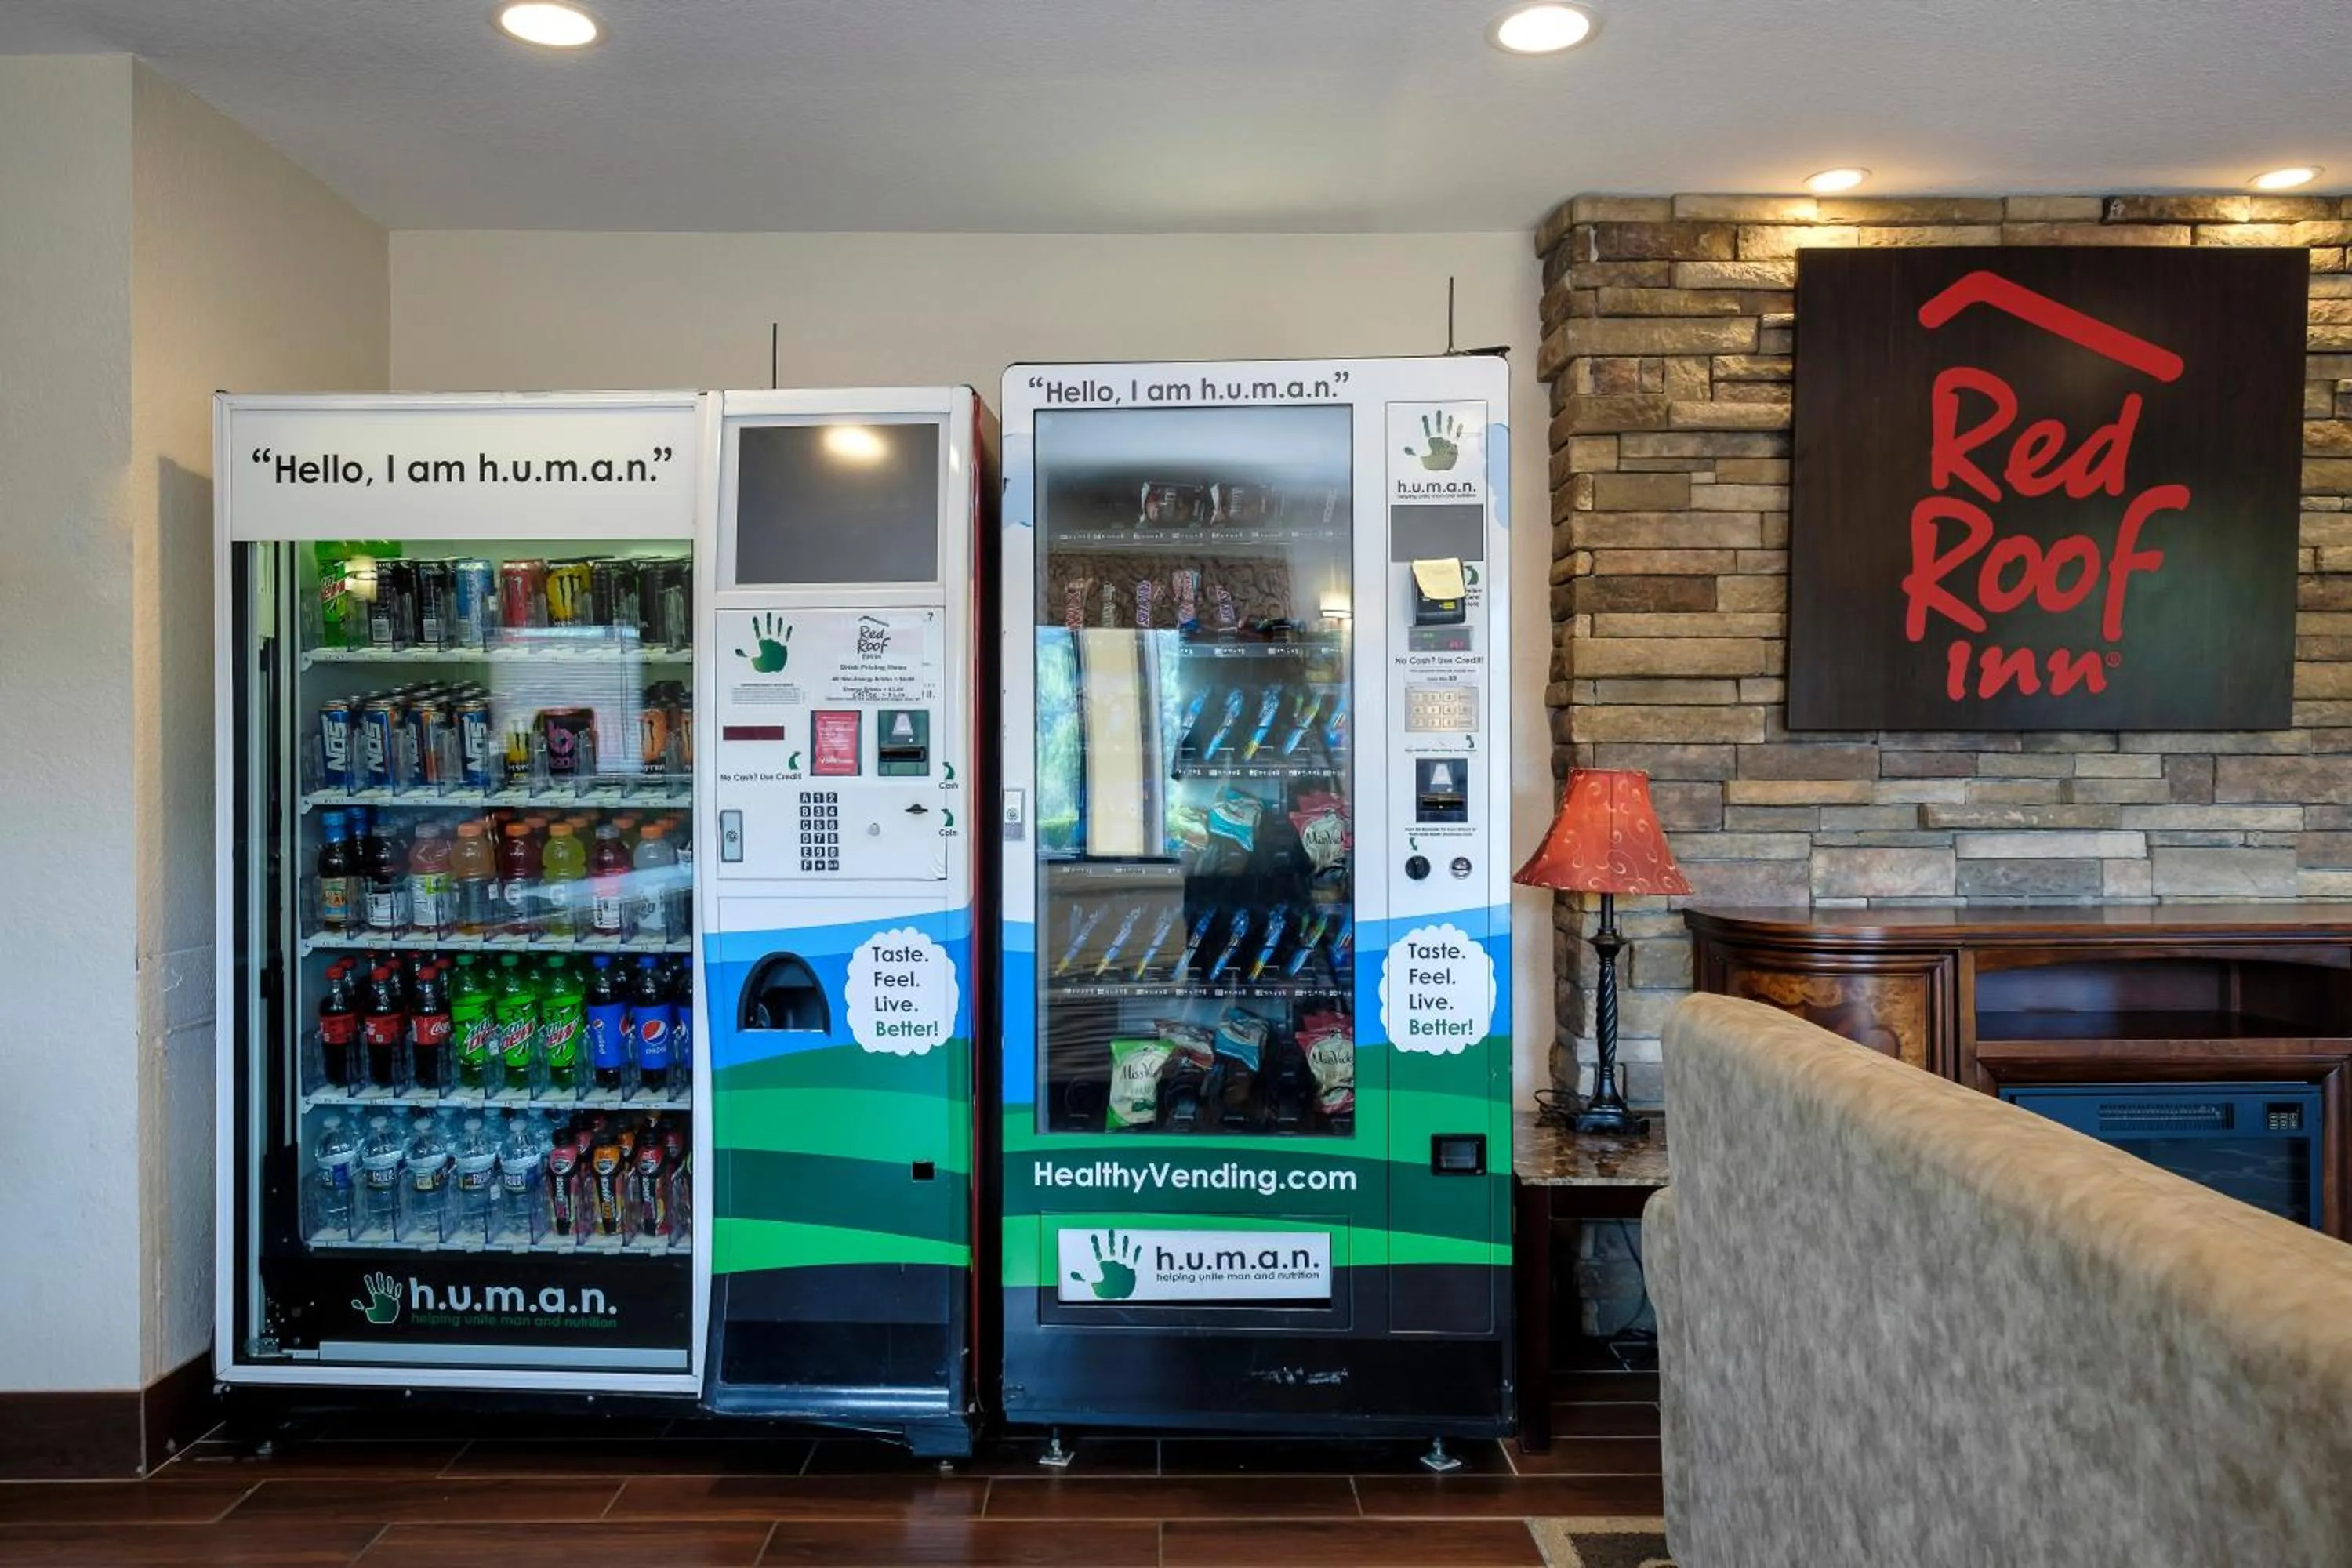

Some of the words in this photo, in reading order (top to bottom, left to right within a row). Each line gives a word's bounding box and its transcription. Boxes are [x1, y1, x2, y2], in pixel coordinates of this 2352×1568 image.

[1029, 377, 1120, 405] “Hello,
[1131, 379, 1137, 401] I
[1147, 383, 1191, 401] am
[1931, 366, 2142, 502] Red
[252, 448, 374, 486] “Hello,
[387, 454, 394, 482] I
[407, 460, 466, 482] am
[1398, 480, 1476, 493] h.u.m.a.n.
[1901, 484, 2190, 642] Roof
[872, 946, 929, 962] Taste.
[1407, 942, 1466, 959] Taste.
[874, 971, 920, 987] Feel.
[1409, 968, 1456, 985] Feel.
[874, 996, 918, 1012] Live.
[1409, 993, 1454, 1010] Live.
[876, 1021, 938, 1036] Better!
[1409, 1019, 1473, 1035] Better!
[1034, 1162, 1357, 1195] HealthyVending.com
[1156, 1246, 1319, 1271] h.u.m.a.n.
[1156, 1272, 1195, 1283] helping
[1199, 1272, 1224, 1281] unite
[1254, 1271, 1275, 1280] and
[1277, 1271, 1319, 1279] nutrition
[408, 1277, 618, 1315] h.u.m.a.n.
[411, 1313, 460, 1327] helping
[500, 1316, 531, 1326] man
[534, 1316, 561, 1327] and
